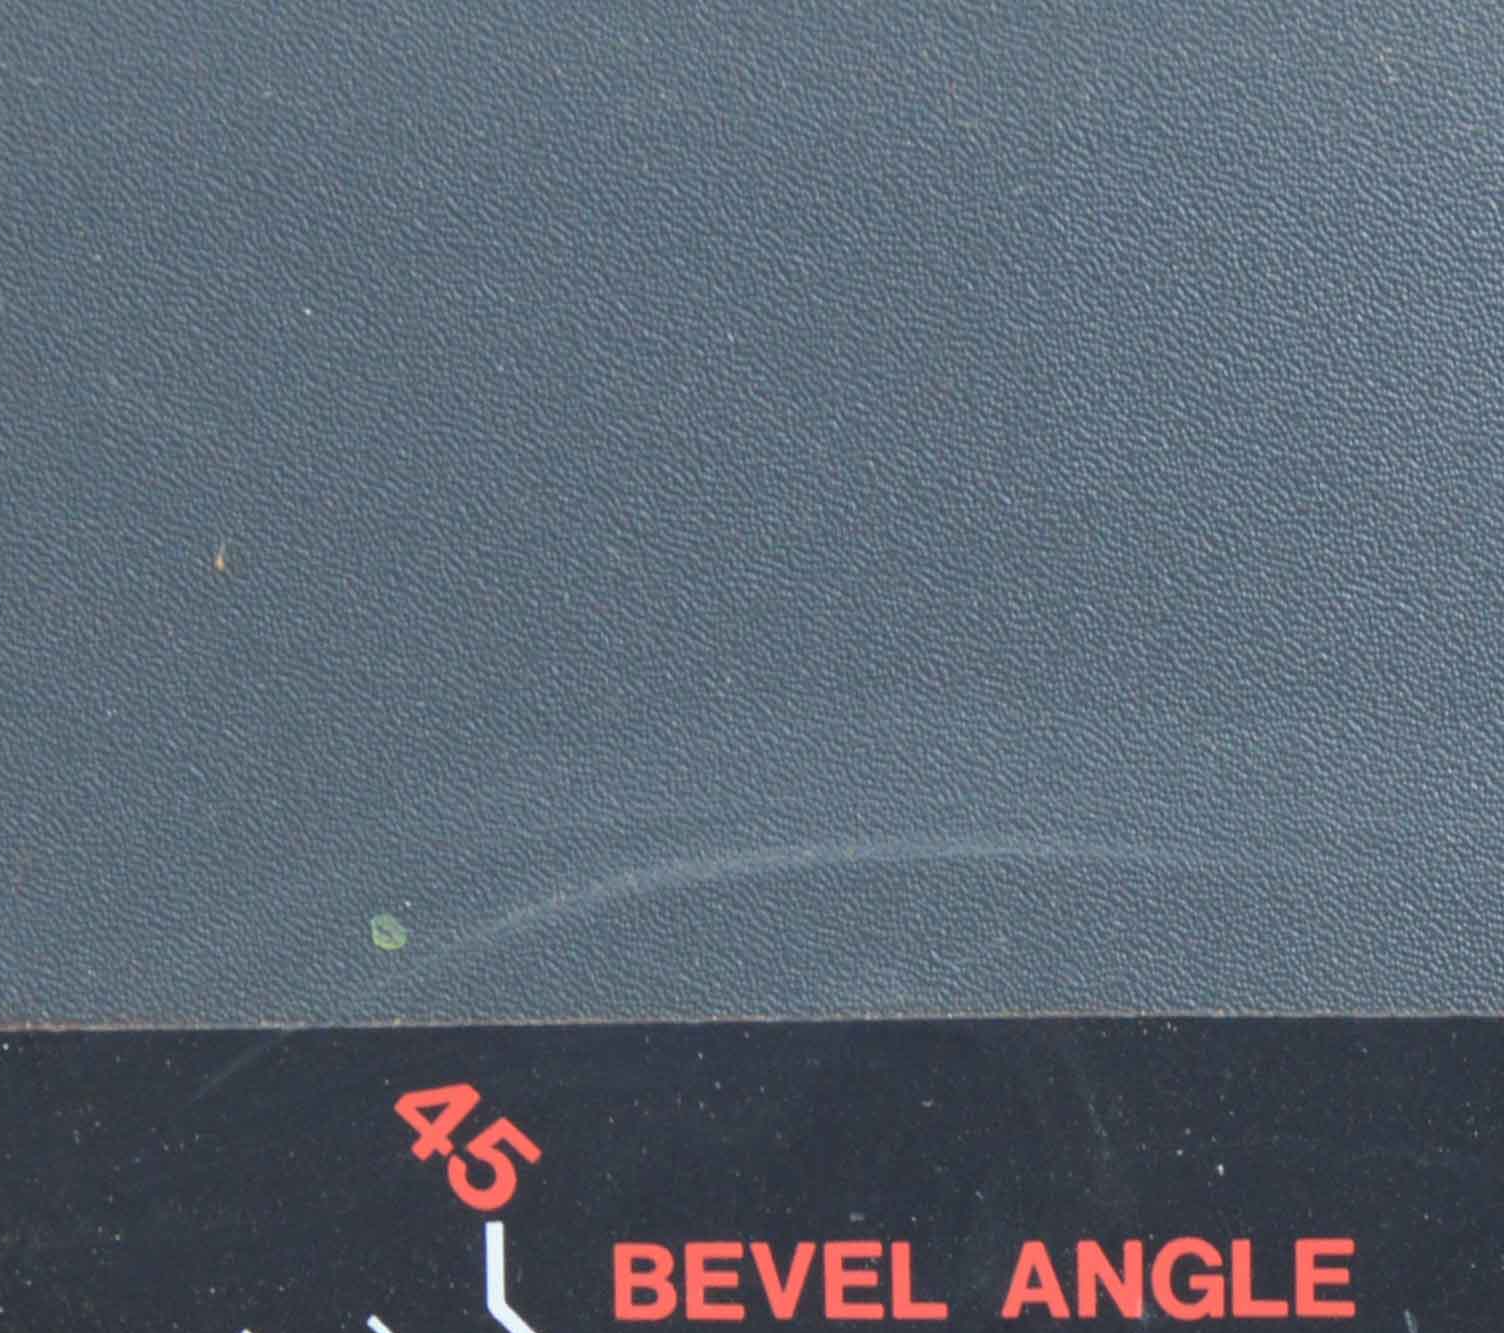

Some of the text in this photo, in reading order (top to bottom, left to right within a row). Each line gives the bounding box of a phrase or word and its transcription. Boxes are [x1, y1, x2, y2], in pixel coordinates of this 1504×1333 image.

[393, 1082, 543, 1213] 45
[612, 1236, 1358, 1322] BEVEL ANGLE
